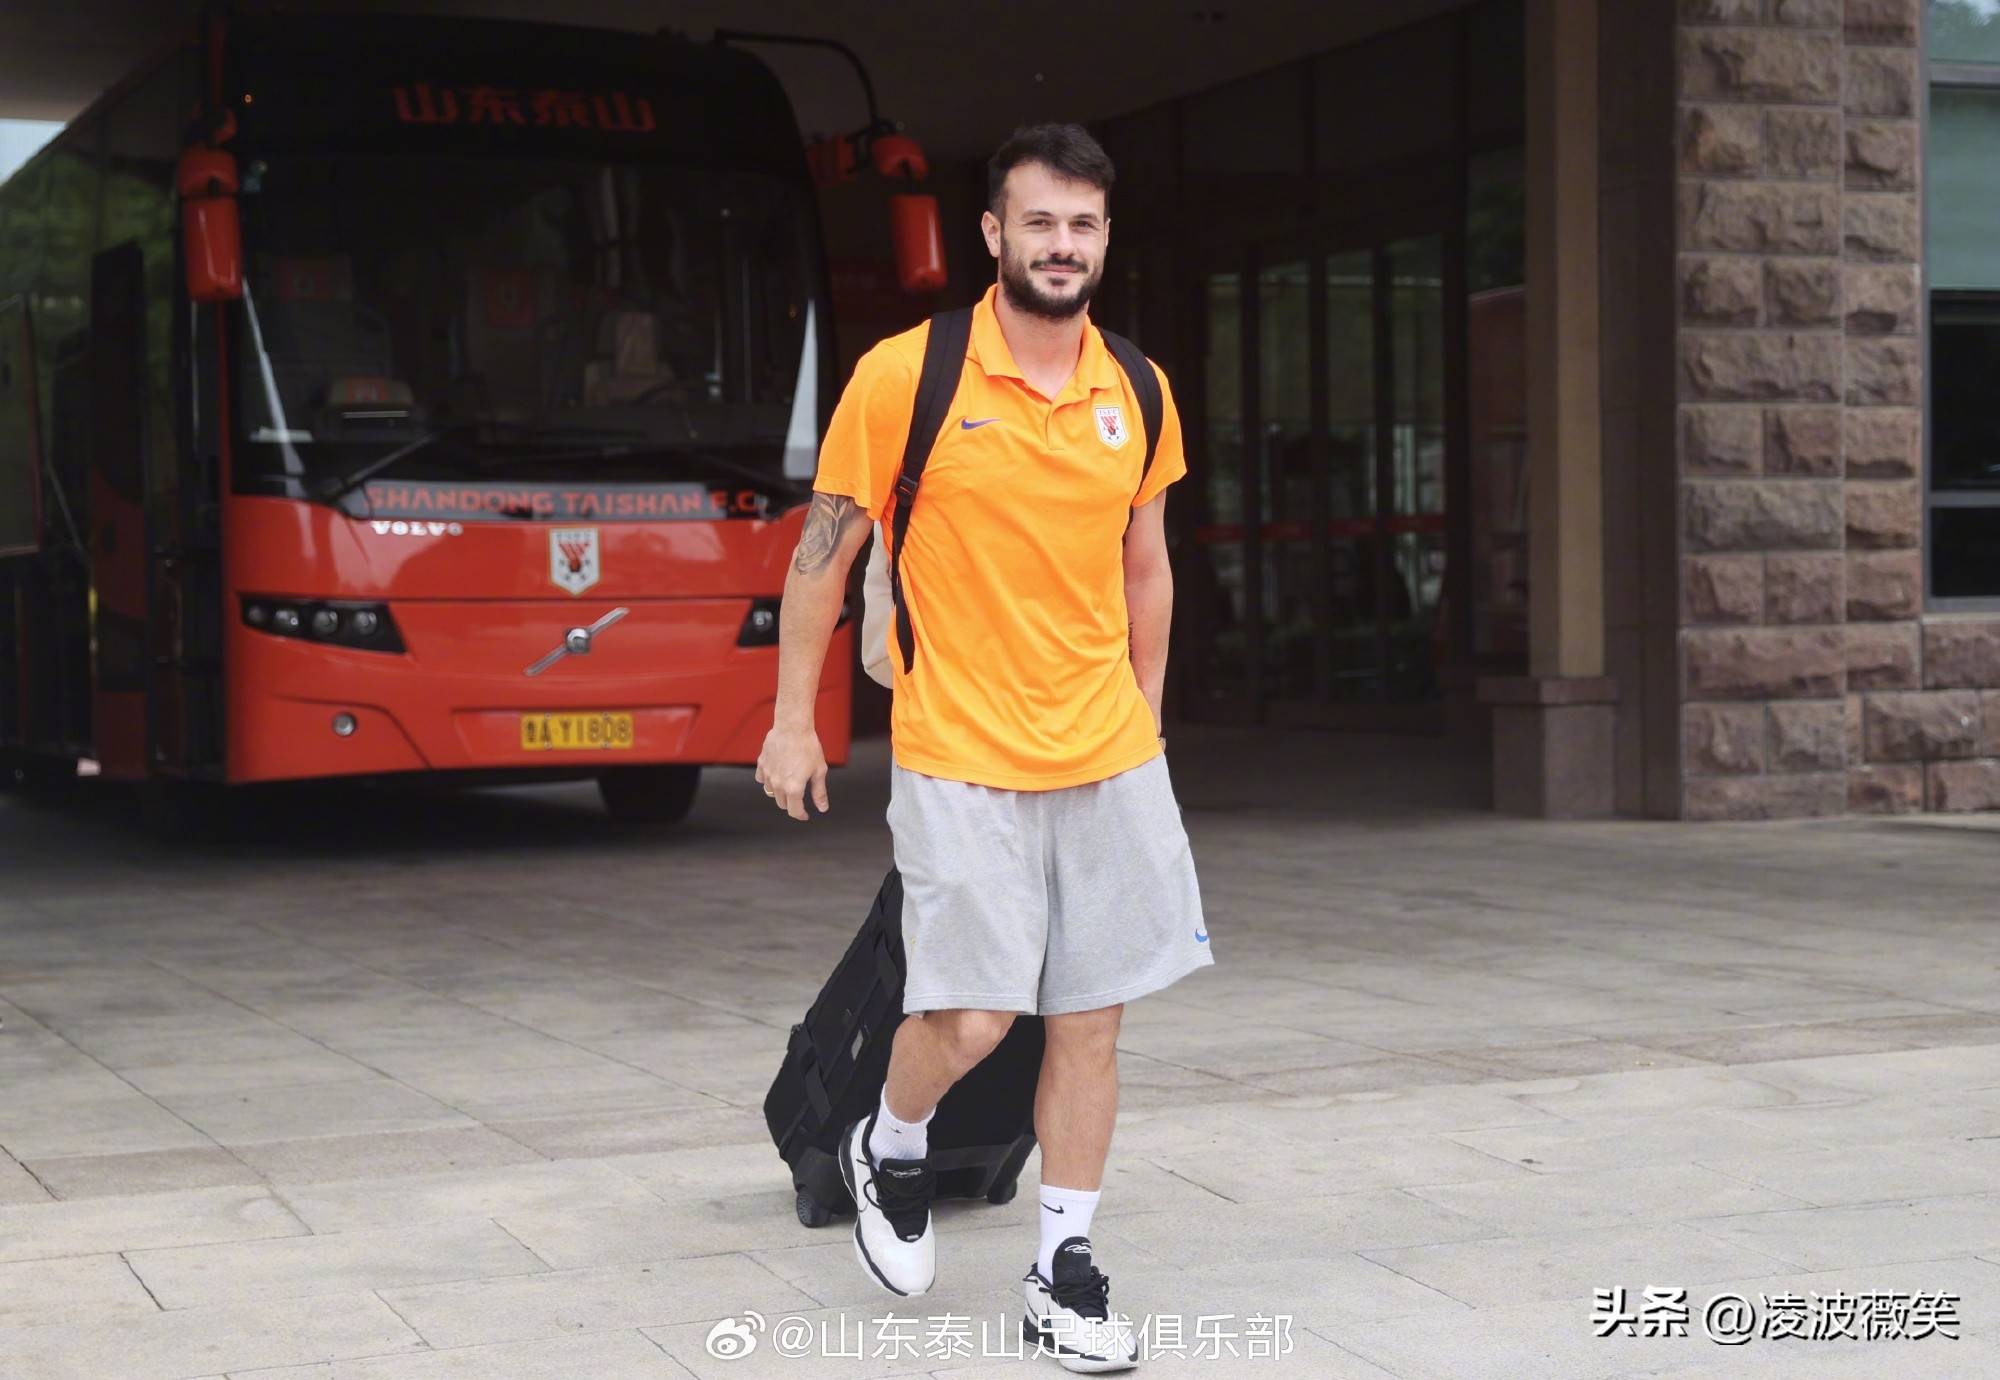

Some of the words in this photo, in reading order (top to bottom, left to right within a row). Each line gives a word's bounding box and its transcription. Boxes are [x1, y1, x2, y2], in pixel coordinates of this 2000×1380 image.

[392, 82, 657, 133] 山东泰山
[364, 486, 555, 514] SHANDONG
[562, 490, 706, 514] TAISHAN
[370, 520, 464, 537] VOLVO
